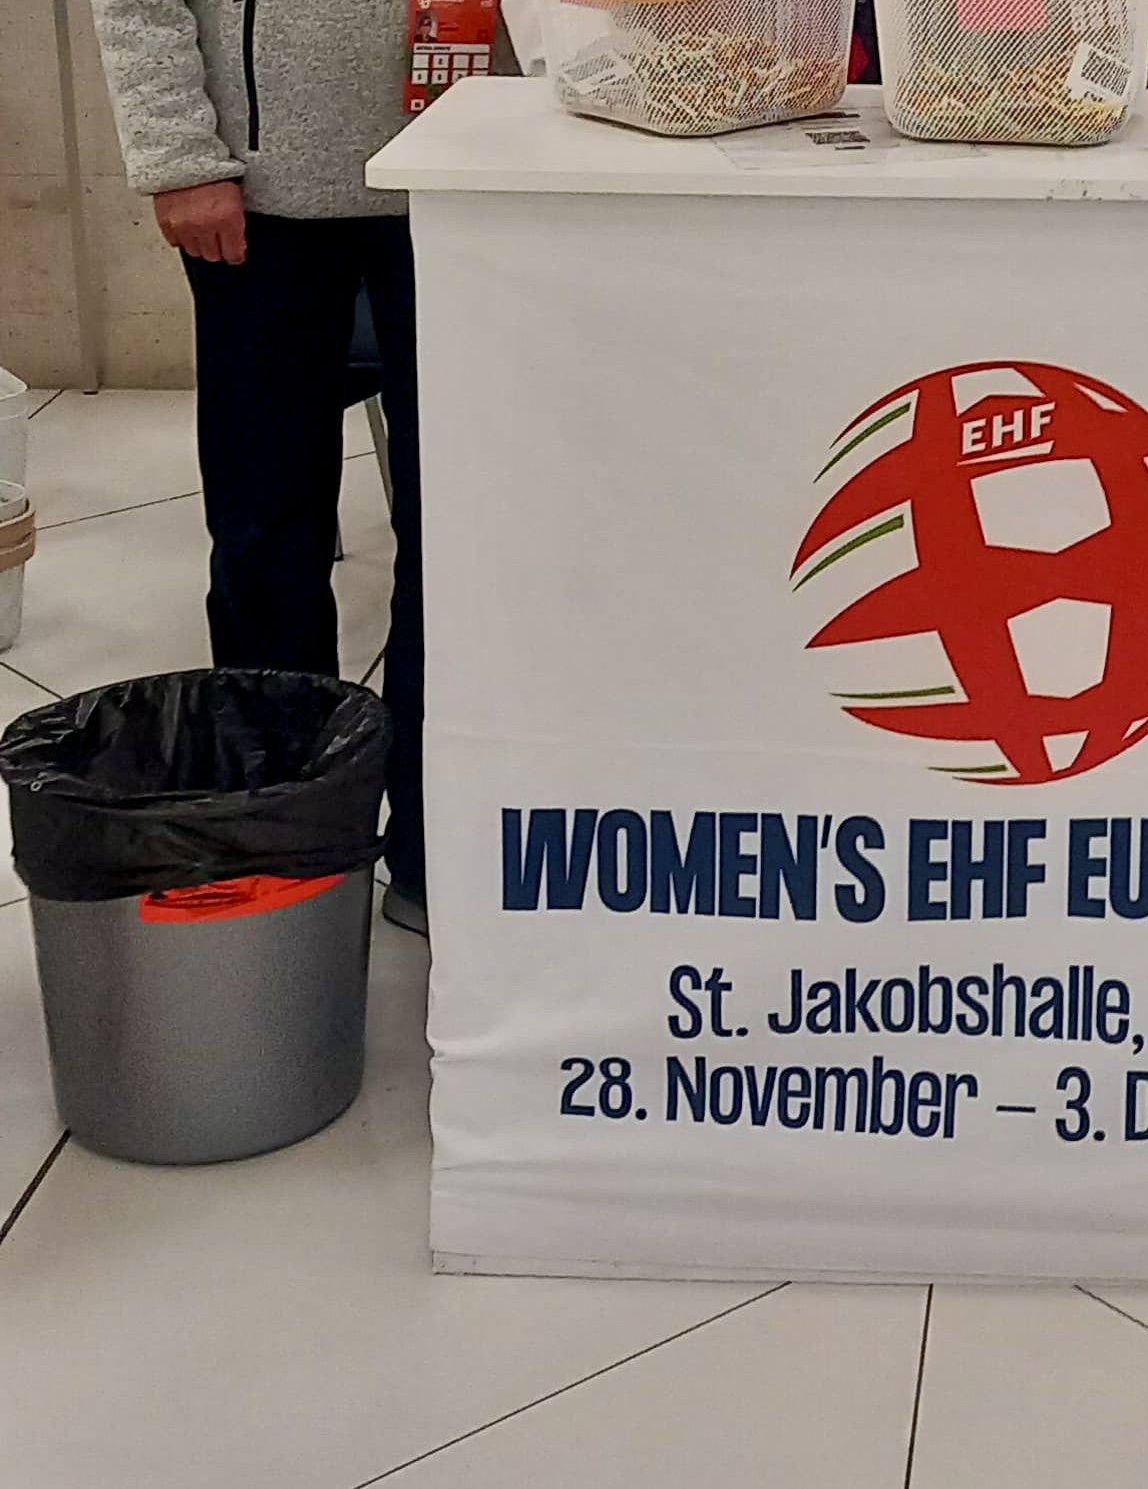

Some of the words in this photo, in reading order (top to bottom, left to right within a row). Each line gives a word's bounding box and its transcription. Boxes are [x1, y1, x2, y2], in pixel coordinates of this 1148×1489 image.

[961, 401, 1057, 456] EHF
[501, 807, 887, 924] WOMEN'S
[906, 817, 1048, 922] EHF
[667, 964, 750, 1039] St.
[767, 962, 1145, 1056] Jakobshalle,
[559, 1056, 649, 1121] 28.
[665, 1055, 979, 1140] November
[1054, 1065, 1107, 1142] 3.
